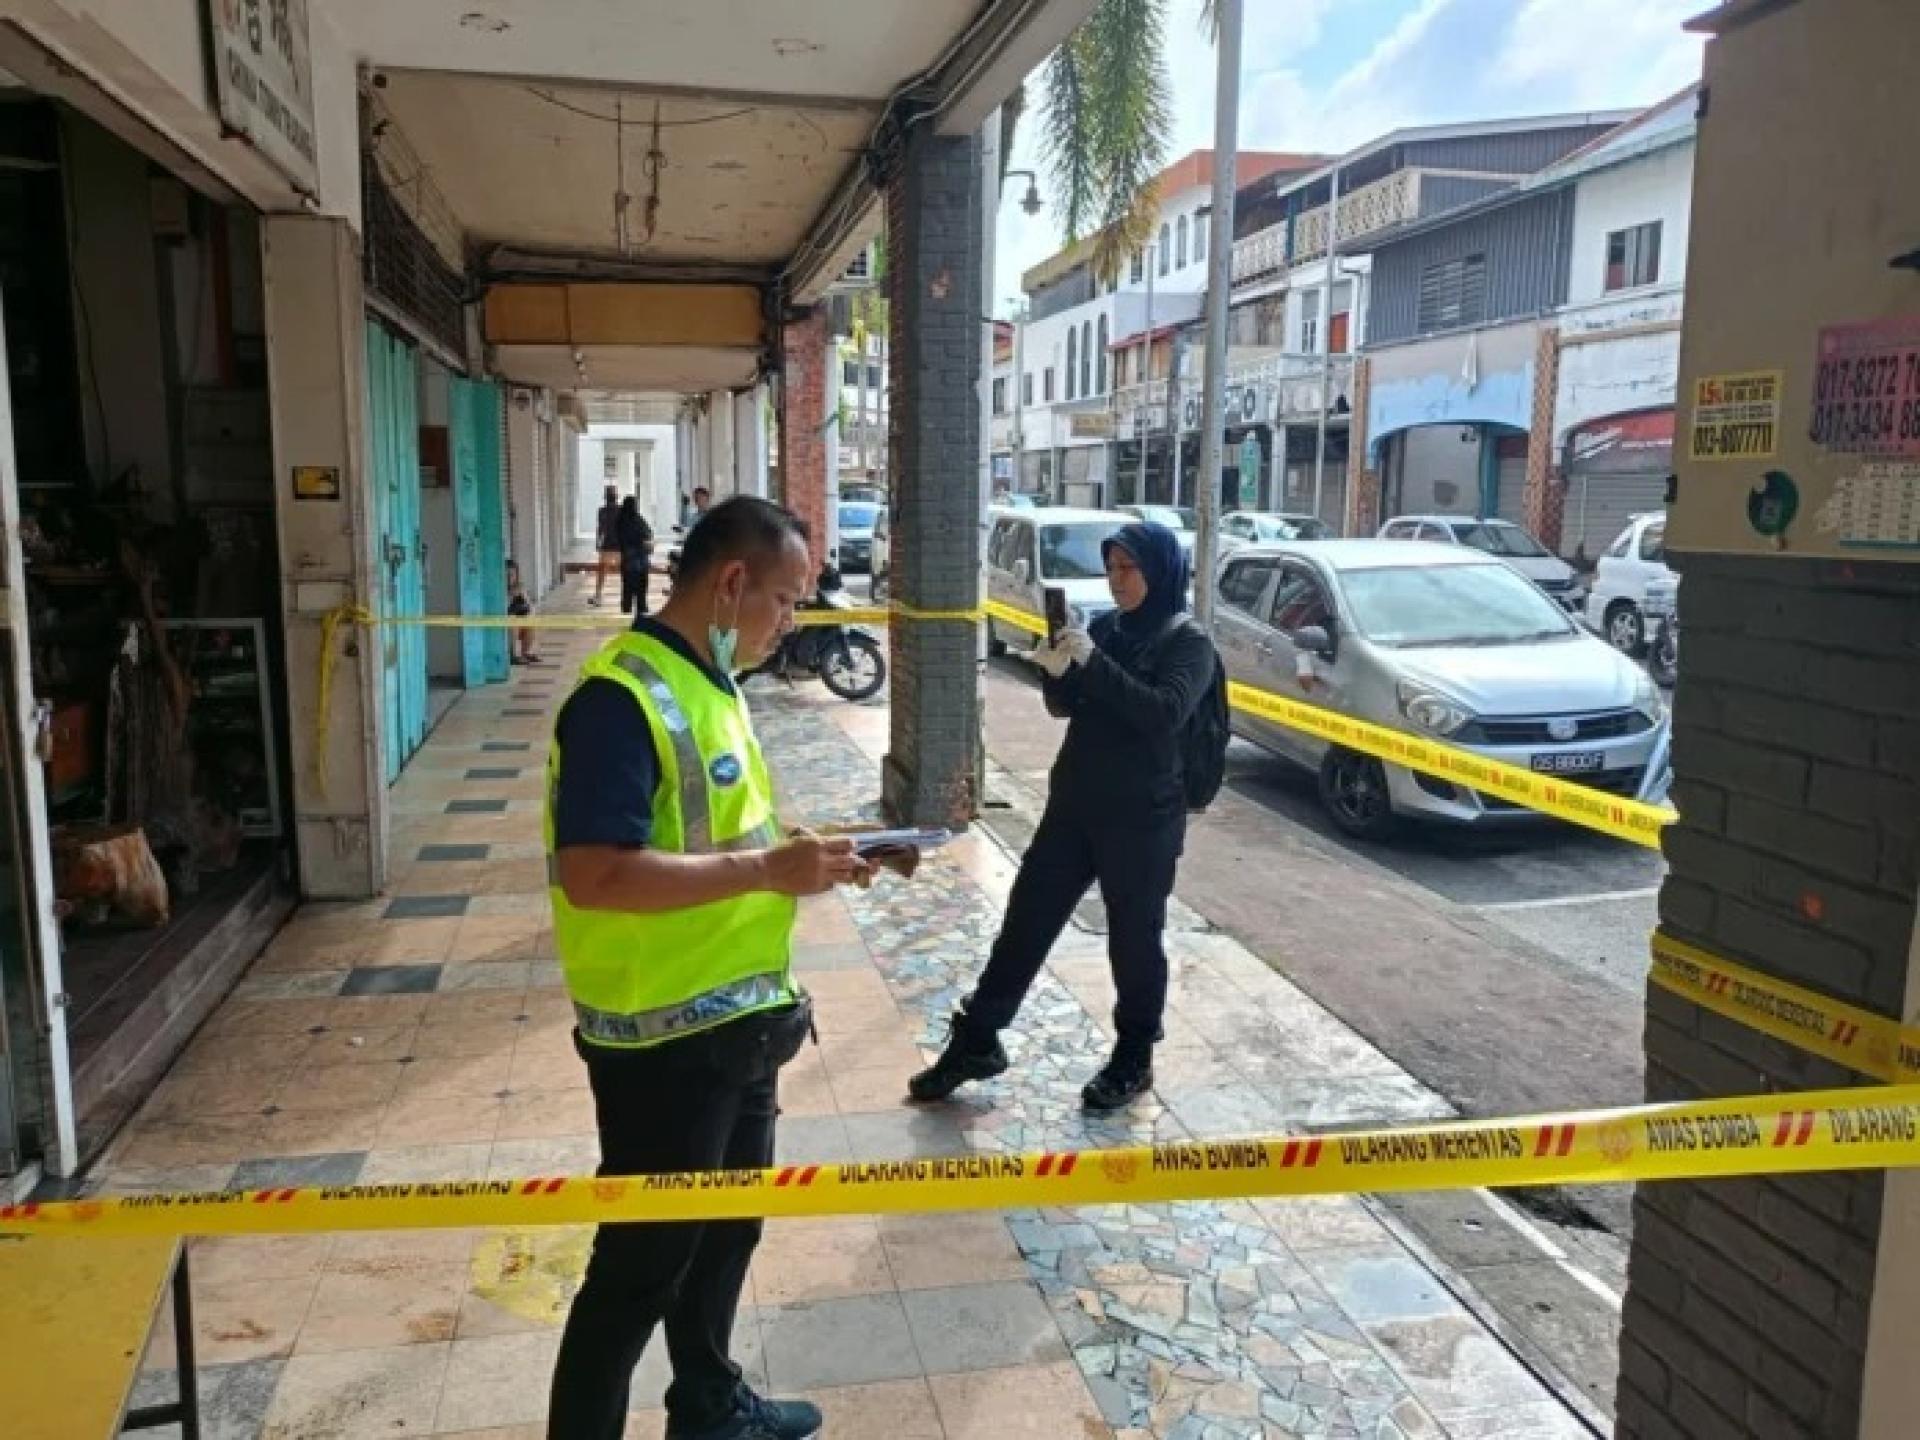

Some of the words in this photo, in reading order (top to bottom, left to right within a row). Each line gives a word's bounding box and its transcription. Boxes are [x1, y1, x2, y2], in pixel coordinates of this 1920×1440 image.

[1153, 1142, 1202, 1173] AWAS
[1206, 1139, 1270, 1169] BOMBA
[1340, 1133, 1427, 1165] DILARANG
[1429, 1127, 1522, 1160] MERENTAS
[1645, 1117, 1695, 1151] AWAS
[1699, 1113, 1761, 1149] BOMBA
[1828, 1105, 1916, 1144] DILARANG
